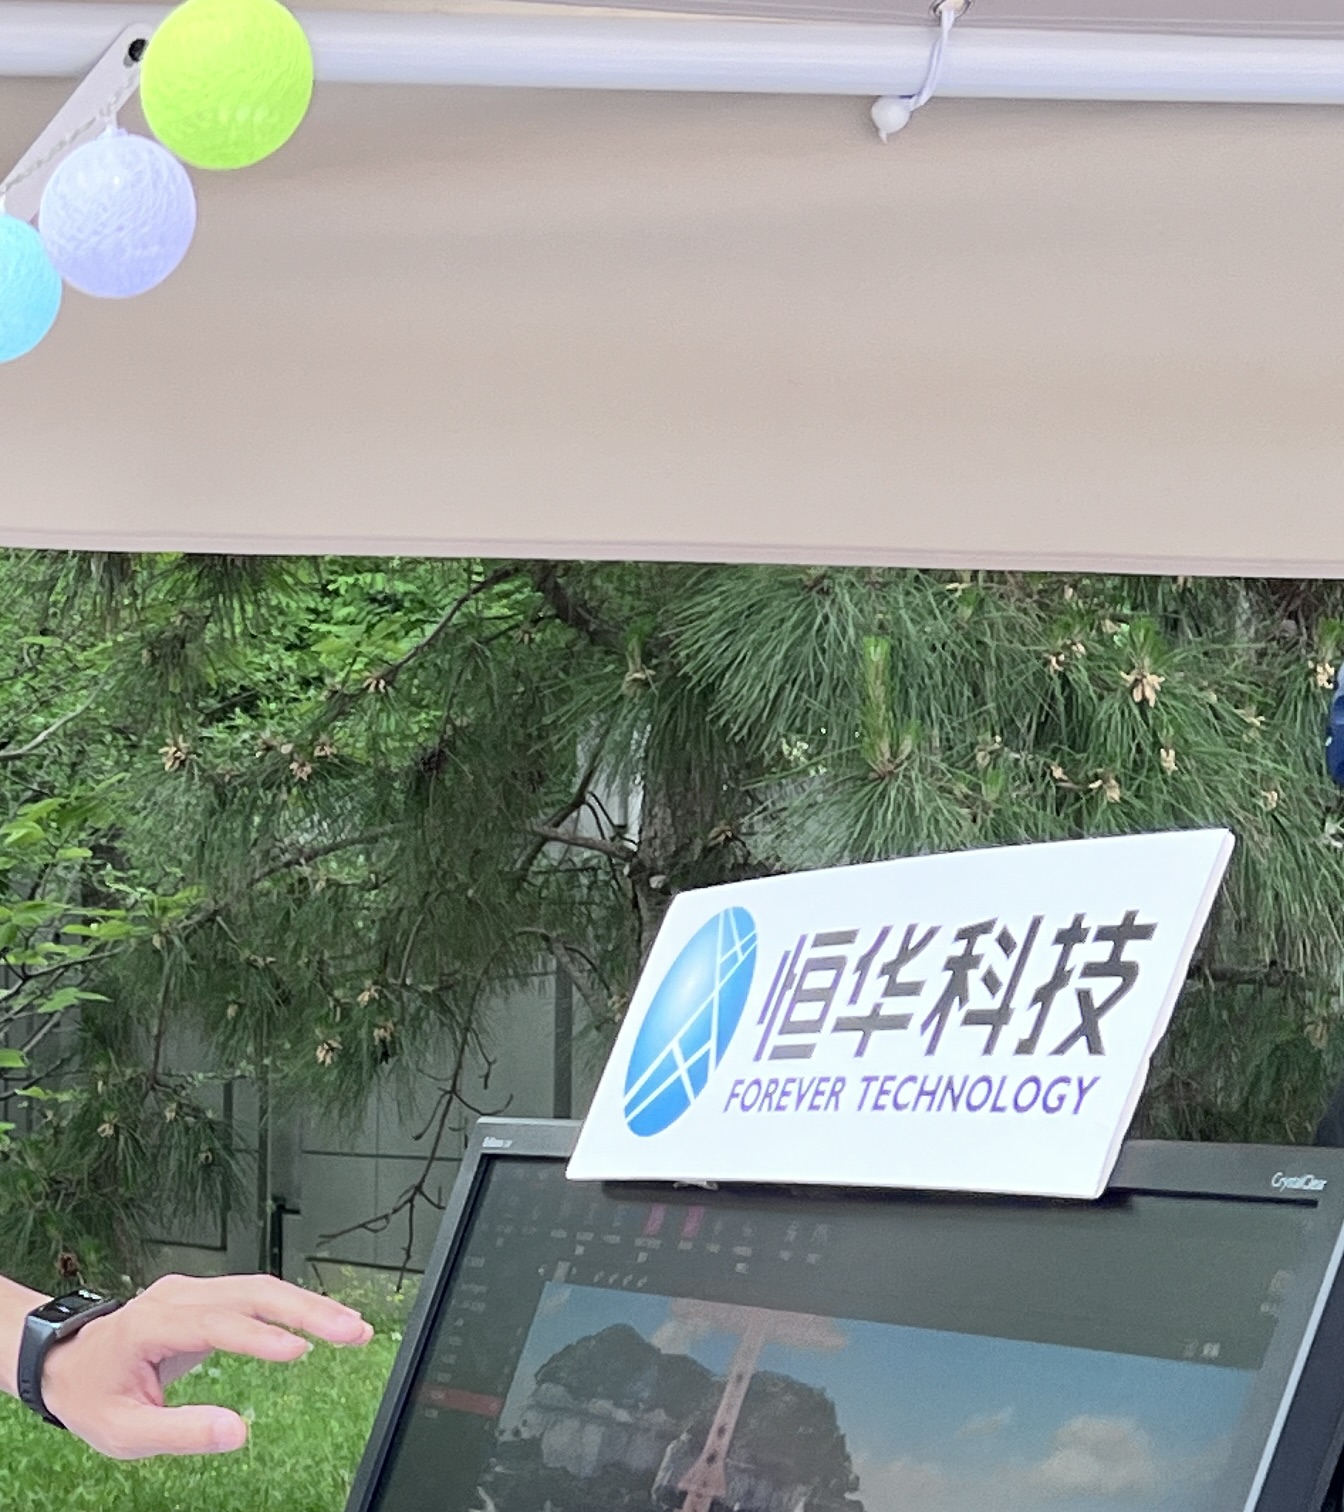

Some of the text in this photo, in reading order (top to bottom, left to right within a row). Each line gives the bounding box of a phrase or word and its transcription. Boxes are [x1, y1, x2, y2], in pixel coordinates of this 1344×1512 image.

[753, 909, 1160, 1062] 恒华科技
[723, 1074, 1102, 1116] FOREVER TECHNOLOGY
